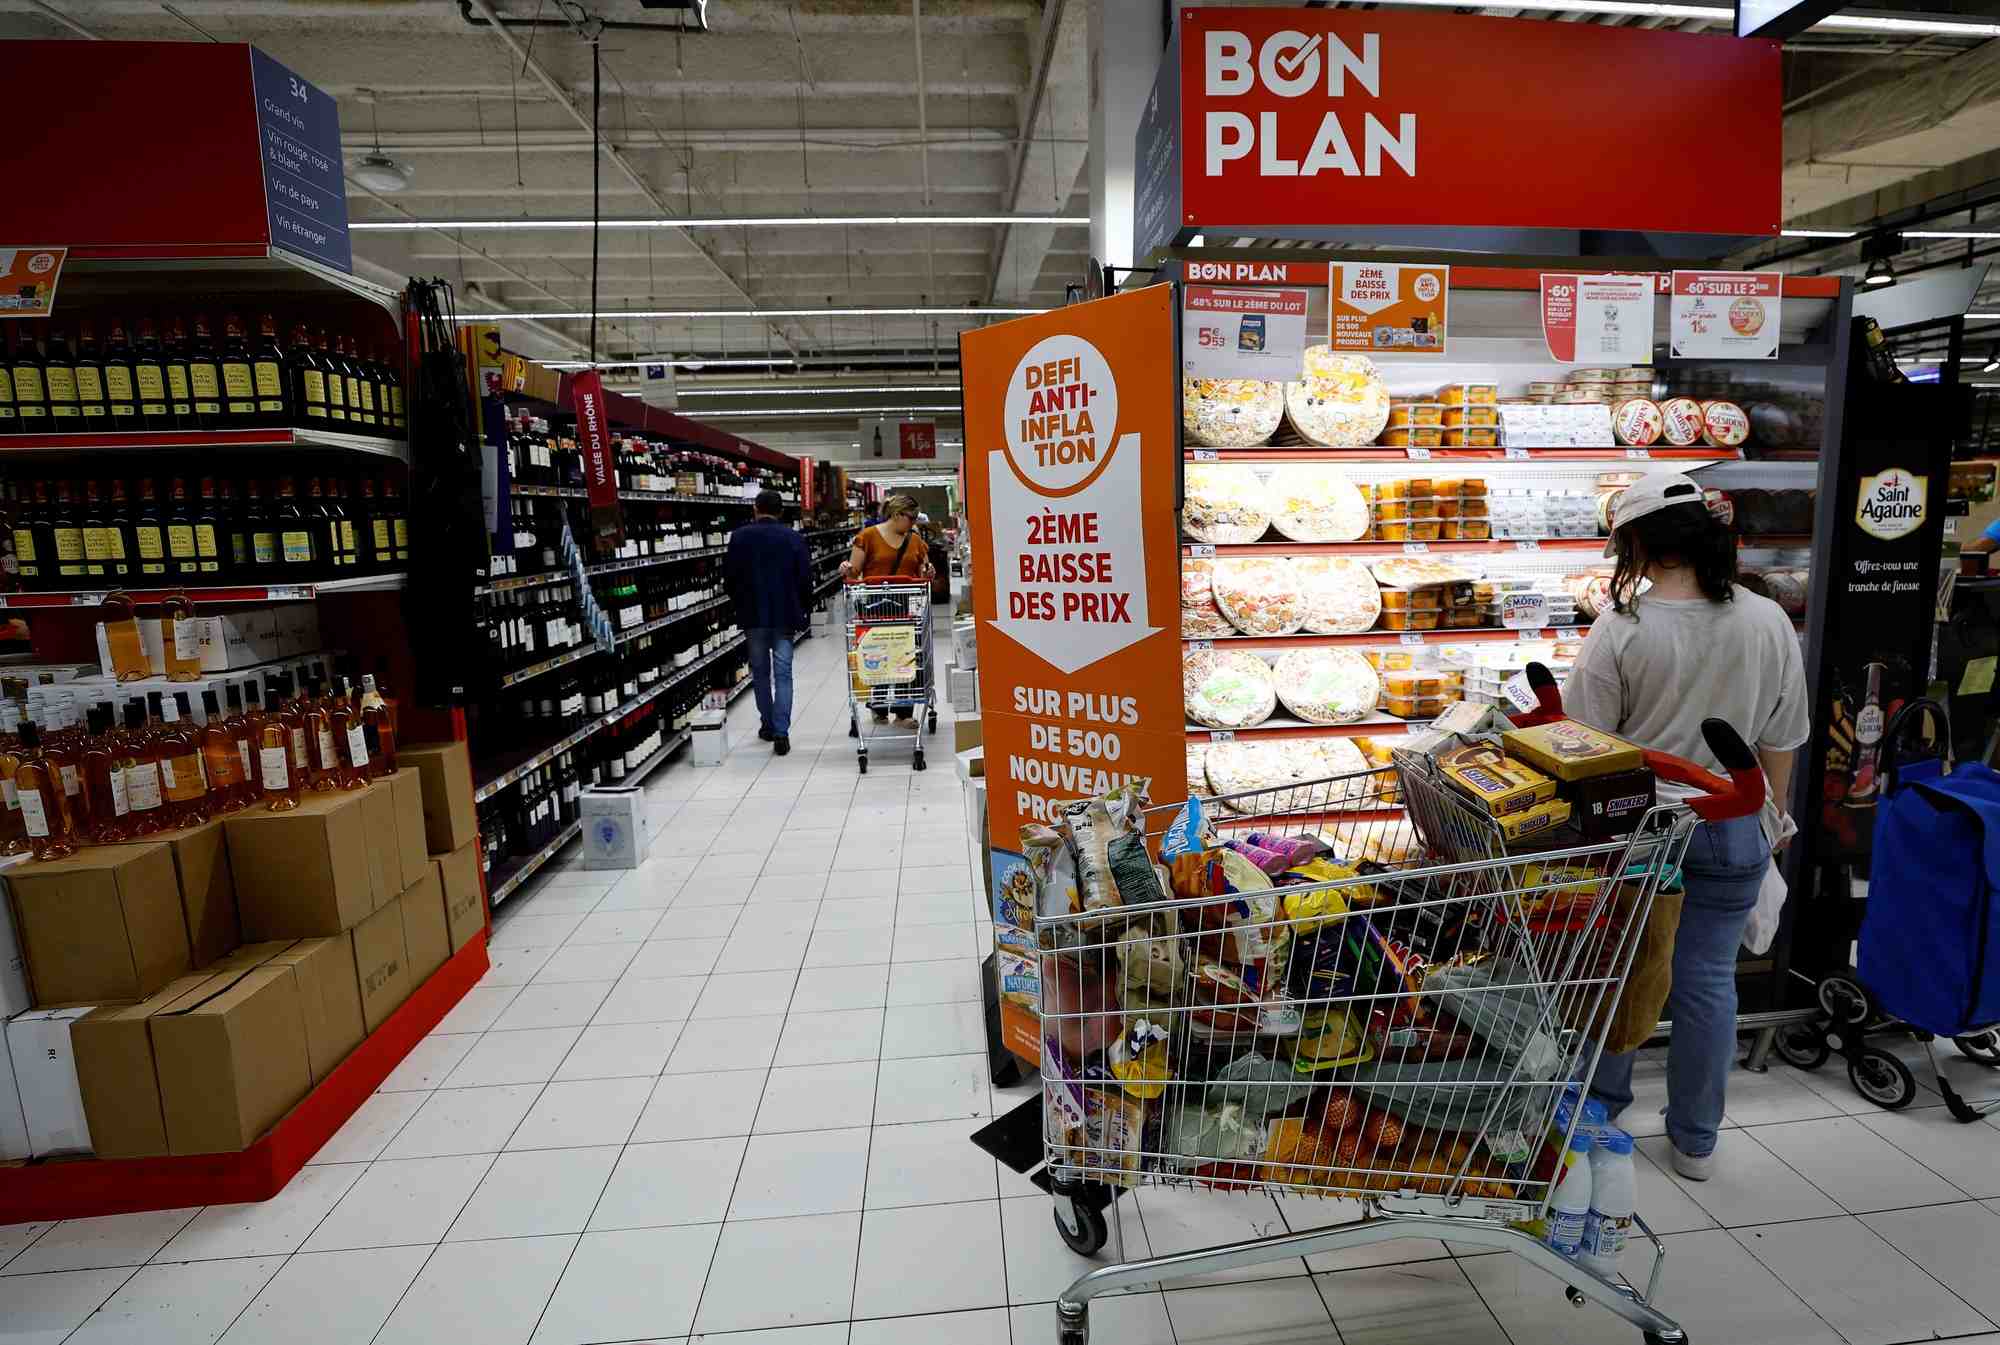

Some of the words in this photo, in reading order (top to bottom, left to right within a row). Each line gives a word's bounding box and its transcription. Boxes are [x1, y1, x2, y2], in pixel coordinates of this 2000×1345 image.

[1204, 30, 1380, 97] BON
[289, 77, 308, 104] 34
[264, 98, 291, 125] Grand
[291, 115, 306, 131] vin
[267, 128, 283, 147] Vin
[311, 153, 329, 172] rosé
[1205, 112, 1416, 177] PLAN
[269, 148, 277, 160] &
[278, 153, 301, 173] blanc
[272, 177, 288, 195] Vin
[288, 185, 300, 201] de
[299, 193, 320, 210] pays
[275, 215, 291, 231] Vin
[291, 221, 327, 246] étranger
[1188, 263, 1231, 280] BON
[1236, 264, 1287, 281] PLAN
[1355, 280, 1387, 289] BAISSE
[1351, 290, 1368, 299] DES
[1370, 291, 1391, 300] PRIX
[1708, 282, 1733, 294] SUR
[1734, 283, 1747, 294] LE
[1284, 302, 1302, 311] LOT
[1025, 356, 1081, 390] DEFI
[583, 393, 599, 432] RHÔNE
[1028, 383, 1097, 415] ANTI-
[591, 434, 601, 450] DU
[1020, 411, 1094, 442] INFLA
[1034, 437, 1096, 467] TION
[1877, 487, 1910, 502] Saint
[1026, 506, 1099, 545] 2ÈME
[1019, 552, 1113, 584] BAISSE
[1855, 560, 1902, 575] Offrez-vous
[1903, 561, 1919, 570] une
[1848, 582, 1880, 593] tranche
[1881, 582, 1892, 592] de
[1891, 580, 1921, 594] finesse
[1009, 591, 1056, 621] DES
[1062, 592, 1132, 624] PRIX
[1013, 686, 1061, 717] SUR
[1067, 691, 1139, 725] PLUS
[1030, 723, 1061, 753] DE
[1067, 729, 1121, 761] 500
[1592, 801, 1603, 816] 18
[1606, 794, 1648, 812] SNICKERS
